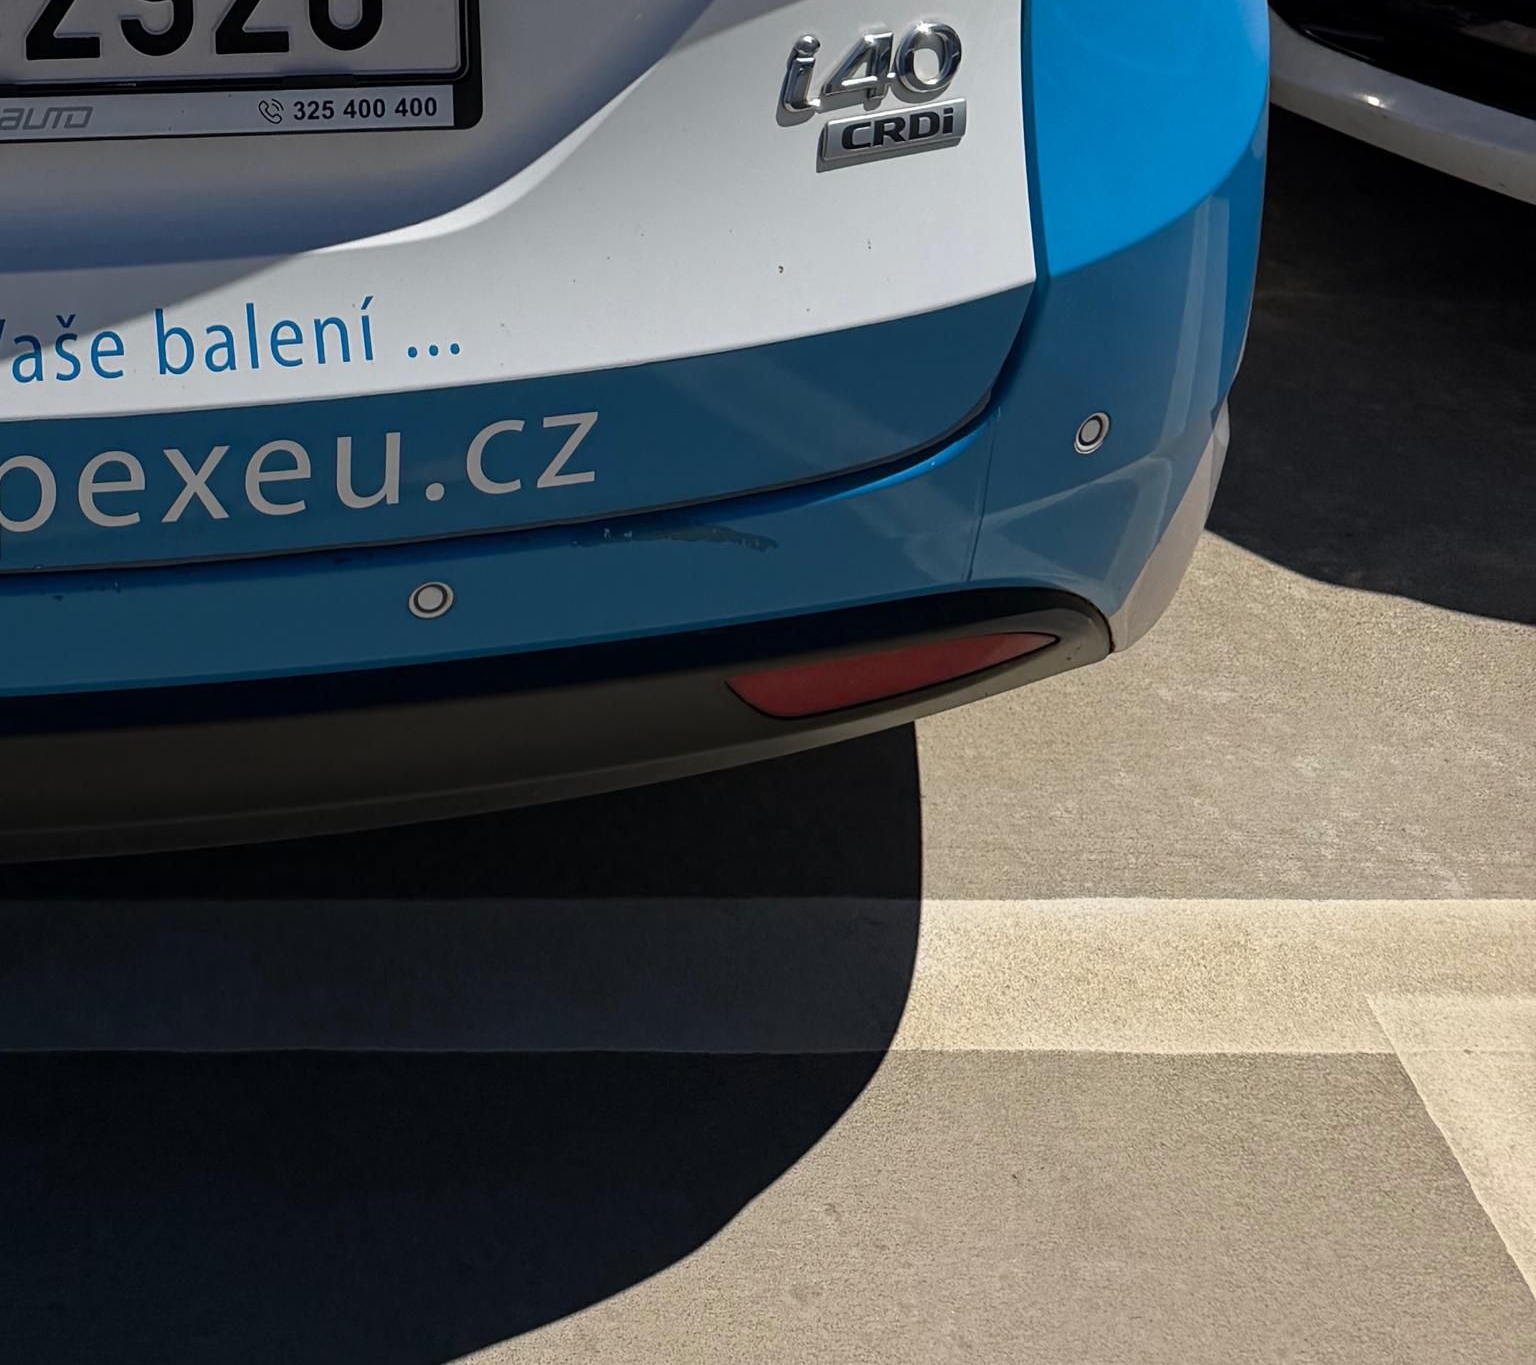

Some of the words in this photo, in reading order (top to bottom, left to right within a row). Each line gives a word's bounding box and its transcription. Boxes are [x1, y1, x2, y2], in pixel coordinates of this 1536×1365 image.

[781, 20, 963, 113] i40
[292, 99, 336, 121] 325
[342, 97, 387, 119] 400
[394, 96, 439, 118] 400
[840, 107, 955, 150] CRDi
[155, 295, 375, 376] balení
